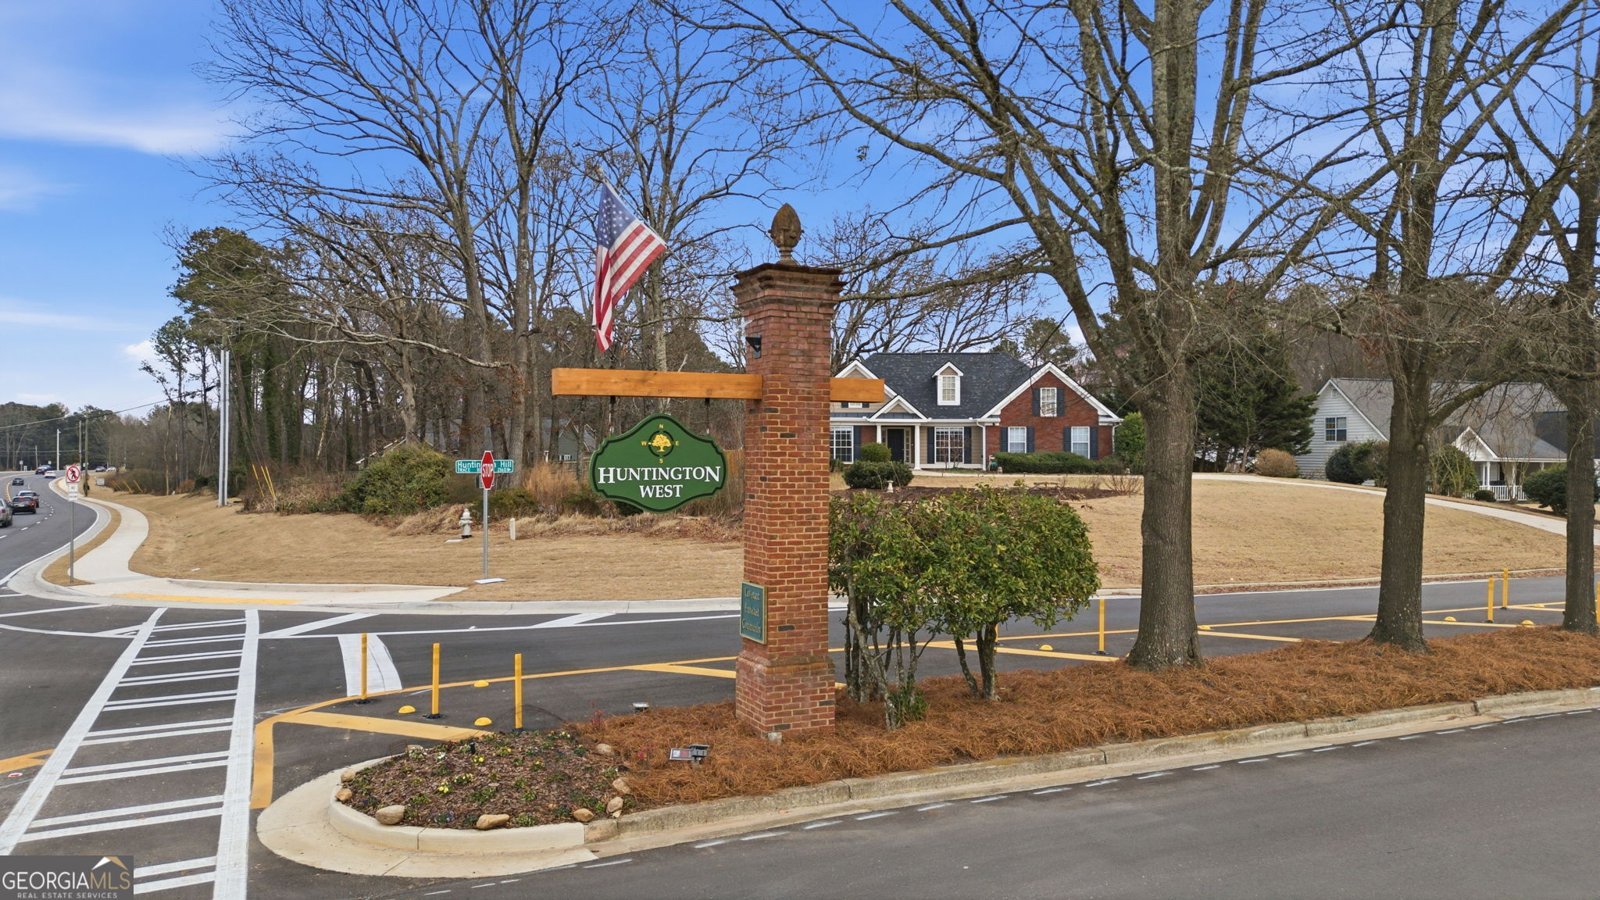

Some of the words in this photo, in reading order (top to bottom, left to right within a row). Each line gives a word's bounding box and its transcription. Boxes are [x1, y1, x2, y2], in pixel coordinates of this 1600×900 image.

[482, 463, 494, 478] STOP
[500, 460, 512, 468] Hill
[598, 466, 721, 484] HUNTINGTON
[639, 484, 683, 498] WEST
